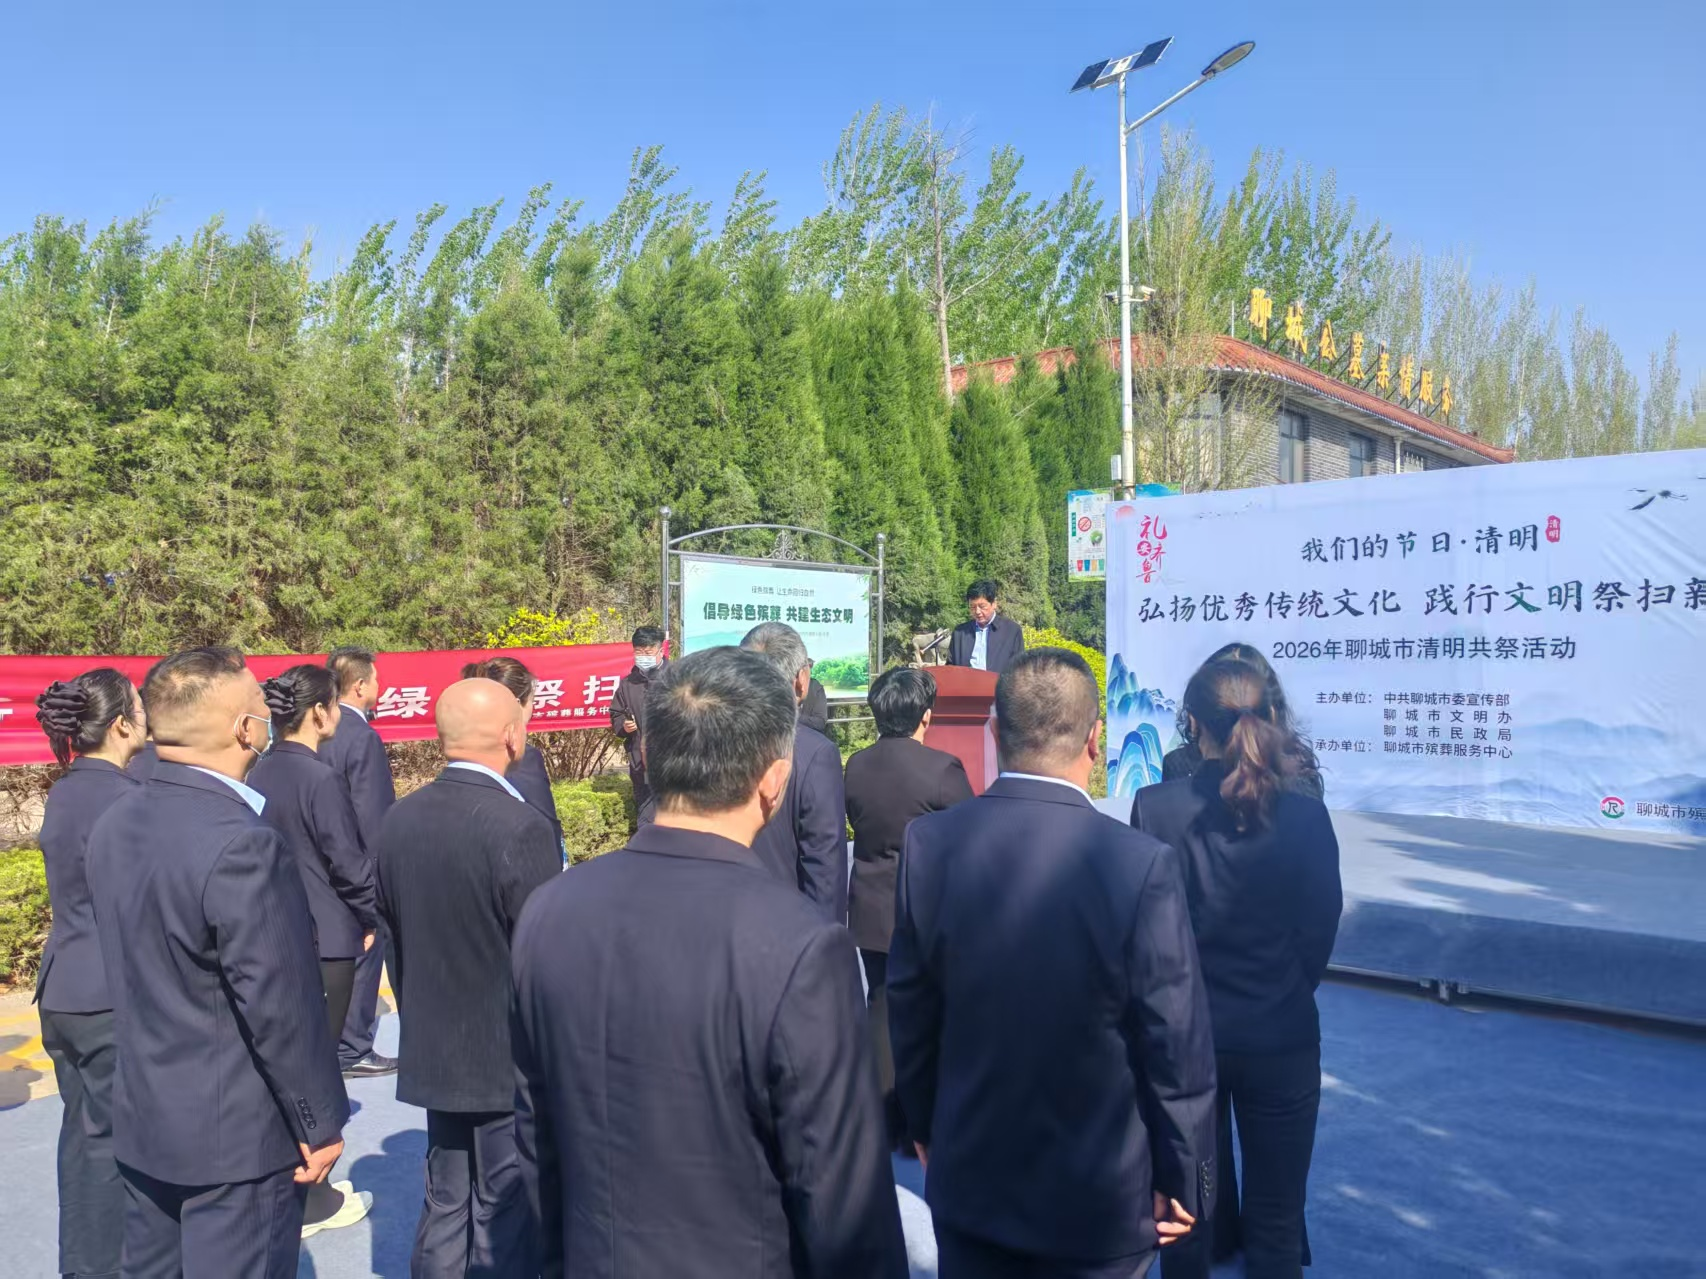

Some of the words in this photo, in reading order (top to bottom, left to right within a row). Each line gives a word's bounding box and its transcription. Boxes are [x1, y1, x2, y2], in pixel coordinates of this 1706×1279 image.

[1301, 524, 1539, 563] 我们的节日·清明
[703, 602, 782, 622] 倡导绿色殡葬
[786, 605, 854, 624] 共建生态文明
[1138, 588, 1402, 624] 弘扬优秀传统文化
[1272, 636, 1577, 661] 2026年聊城市清明共祭活动
[1384, 692, 1511, 707] 中共聊城市委宣传部
[1384, 708, 1512, 724] 聊城市文明办
[1384, 725, 1512, 742] 聊城市民政局
[1384, 741, 1513, 759] 聊城市殡葬服务中心
